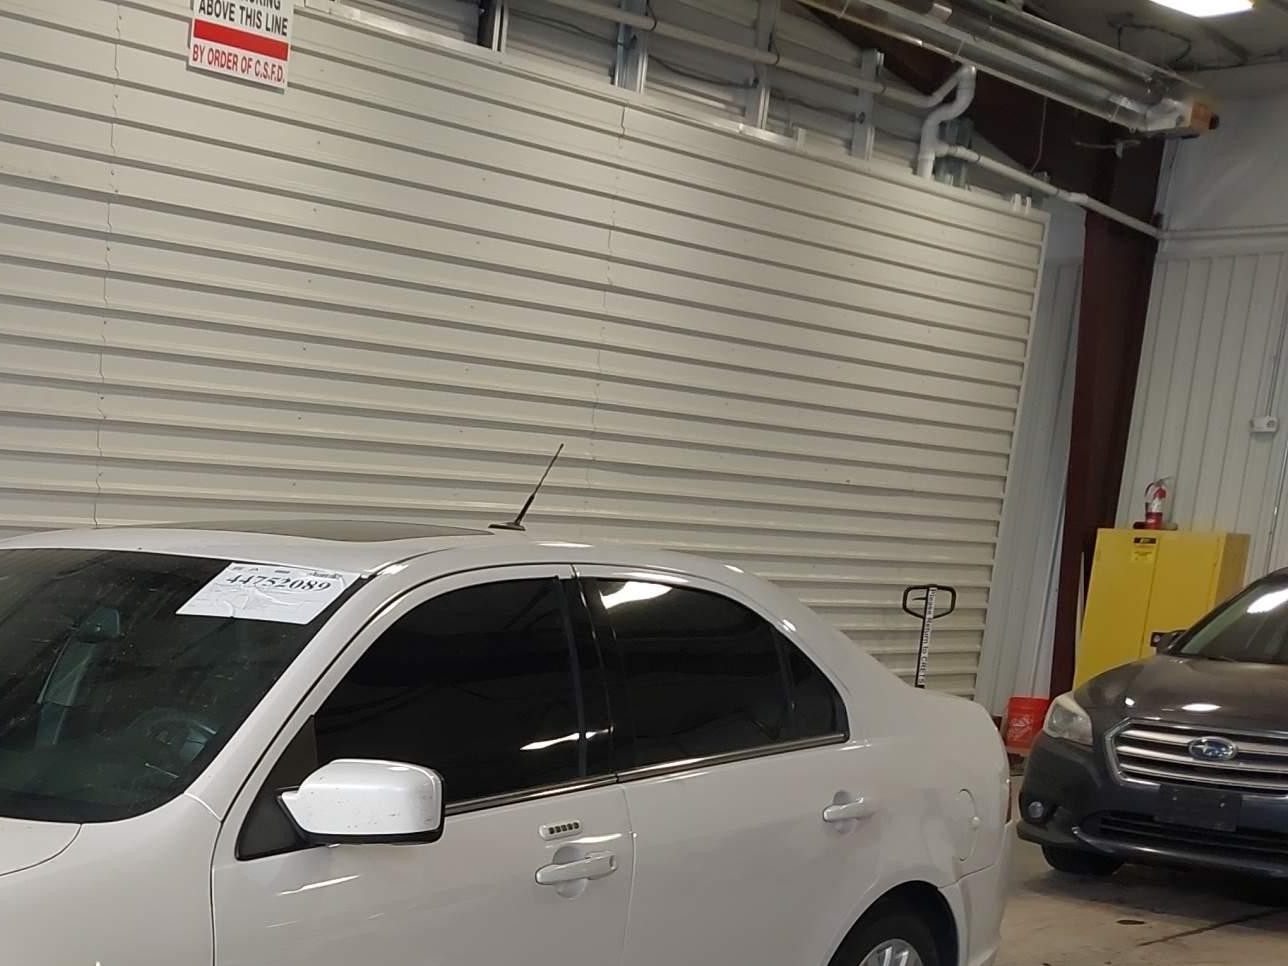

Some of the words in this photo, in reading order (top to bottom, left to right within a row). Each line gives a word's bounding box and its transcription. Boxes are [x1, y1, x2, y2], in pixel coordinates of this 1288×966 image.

[198, 0, 236, 22] ABOVE
[239, 5, 263, 29] THIS
[265, 13, 289, 36] LINE
[192, 44, 206, 63] BY
[207, 48, 239, 71] ORDER
[240, 56, 253, 75] OF
[254, 60, 286, 83] C.S.F.D.
[226, 574, 331, 592] 44752089
